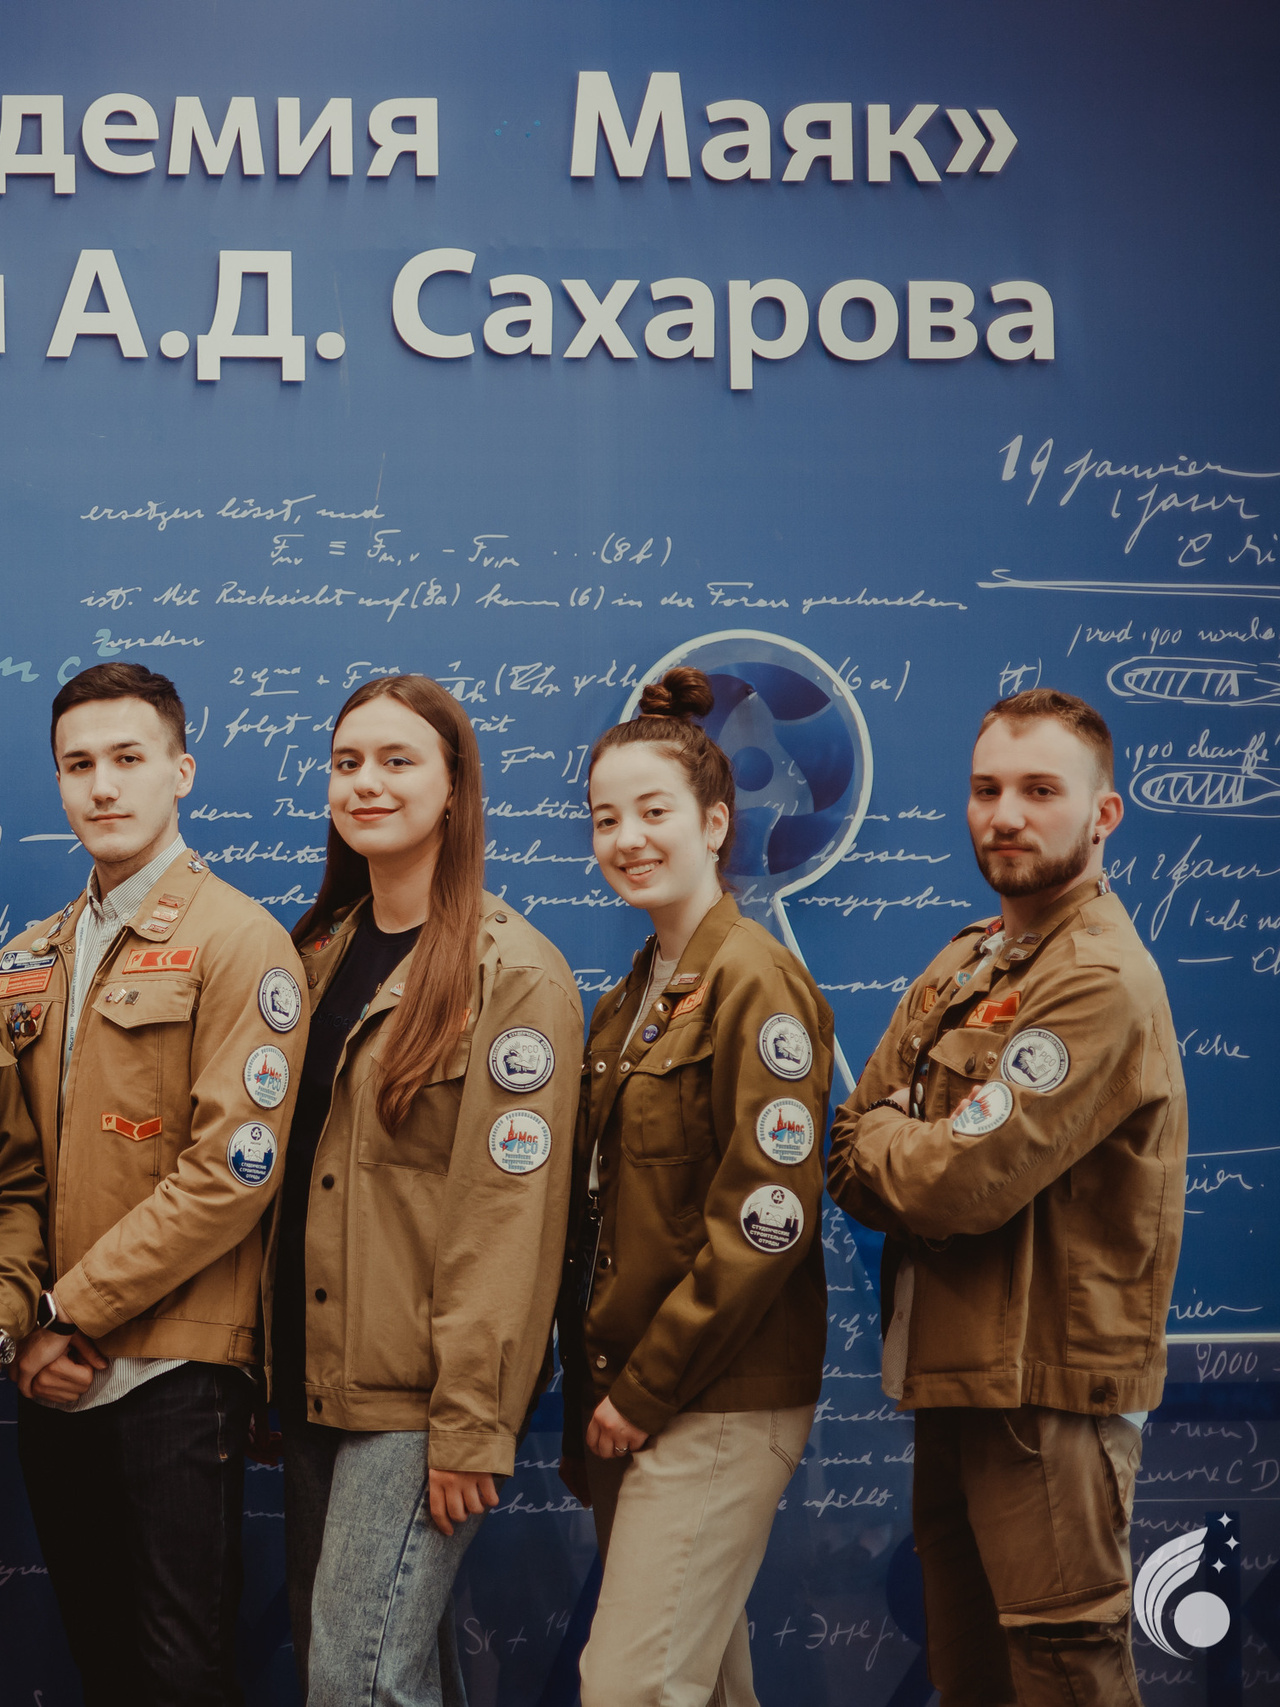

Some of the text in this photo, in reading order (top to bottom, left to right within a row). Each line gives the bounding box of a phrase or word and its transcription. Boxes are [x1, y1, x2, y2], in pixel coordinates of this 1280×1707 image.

[570, 71, 1018, 183] Маяк»
[47, 249, 346, 382] А.Д.
[392, 247, 1056, 390] Сахарова
[522, 1045, 538, 1053] РСО
[1039, 1051, 1056, 1067] РСО
[788, 1131, 805, 1144] РСО
[517, 1141, 538, 1154] РСО
